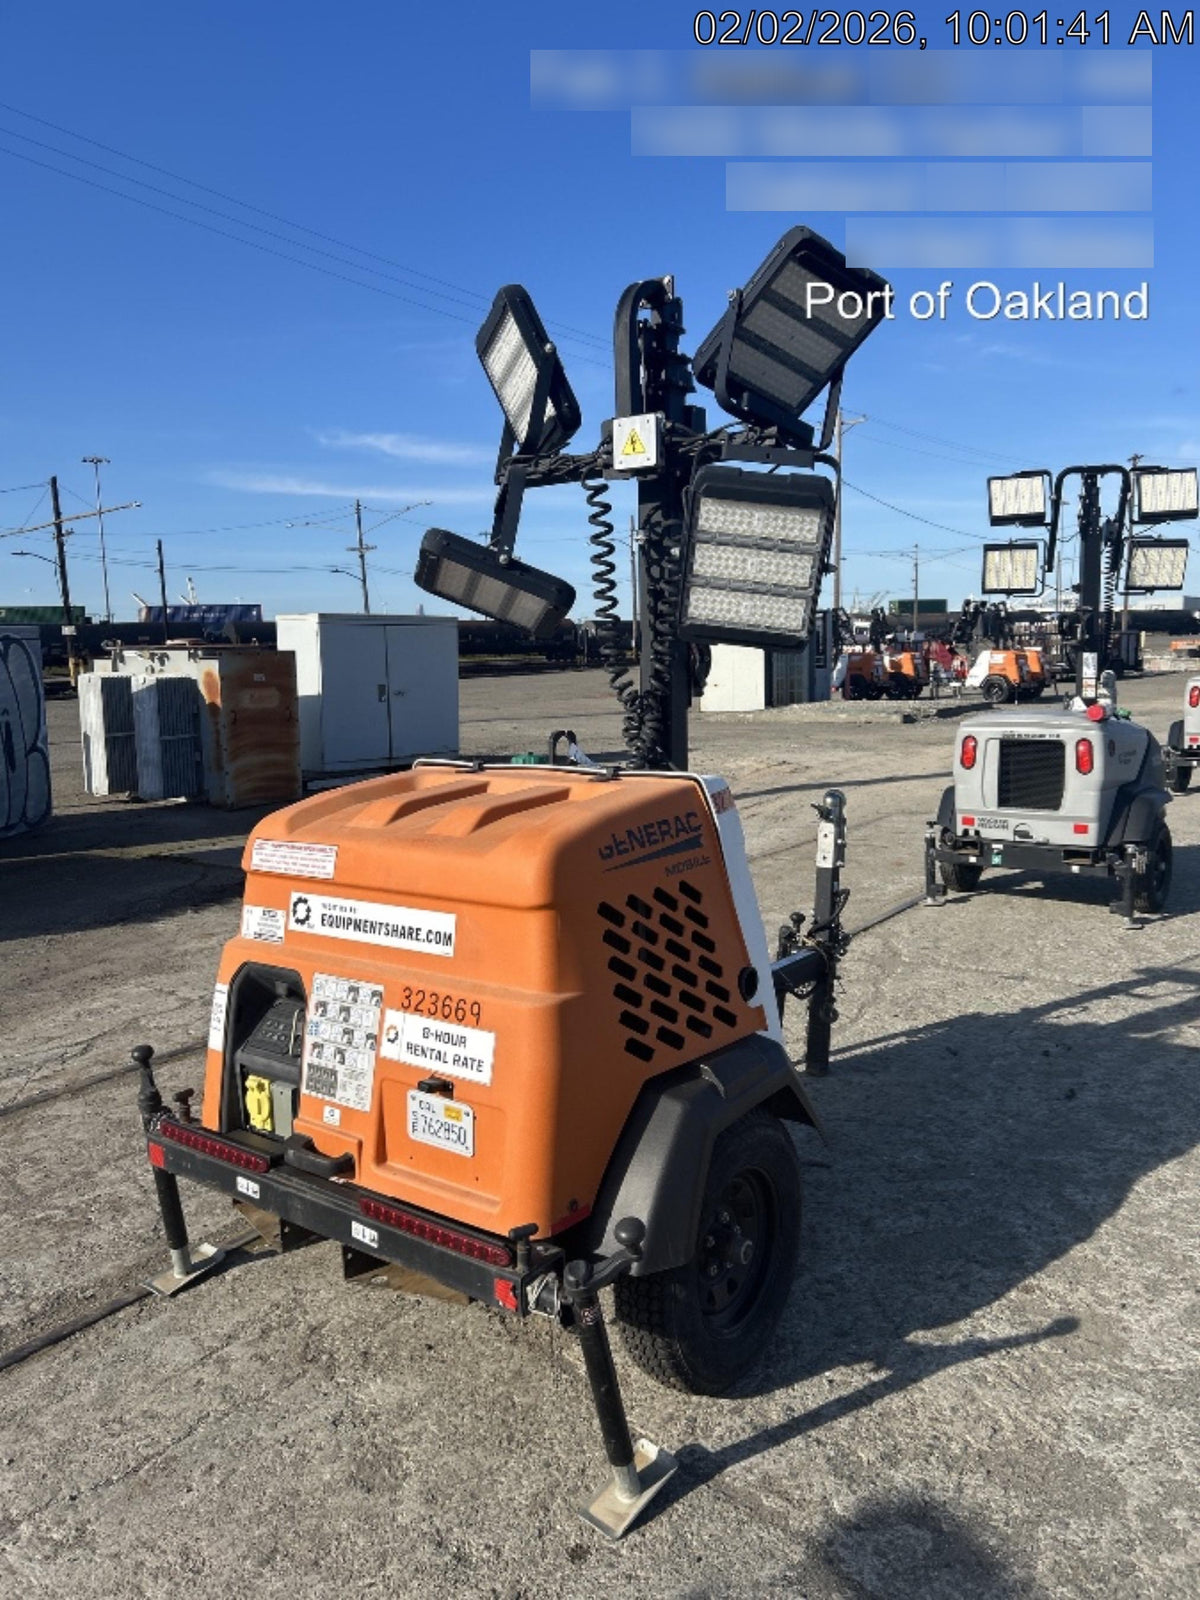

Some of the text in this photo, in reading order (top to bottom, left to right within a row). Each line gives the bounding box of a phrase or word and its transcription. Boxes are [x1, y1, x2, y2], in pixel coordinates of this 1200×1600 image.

[599, 811, 702, 860] GENERAC
[321, 913, 453, 947] EQUIPMENTSHARE.COM
[401, 986, 481, 1026] 323669
[422, 1027, 467, 1048] 8-HOUR
[406, 1041, 485, 1073] RENTAL RATE
[421, 1114, 467, 1146] 762850
